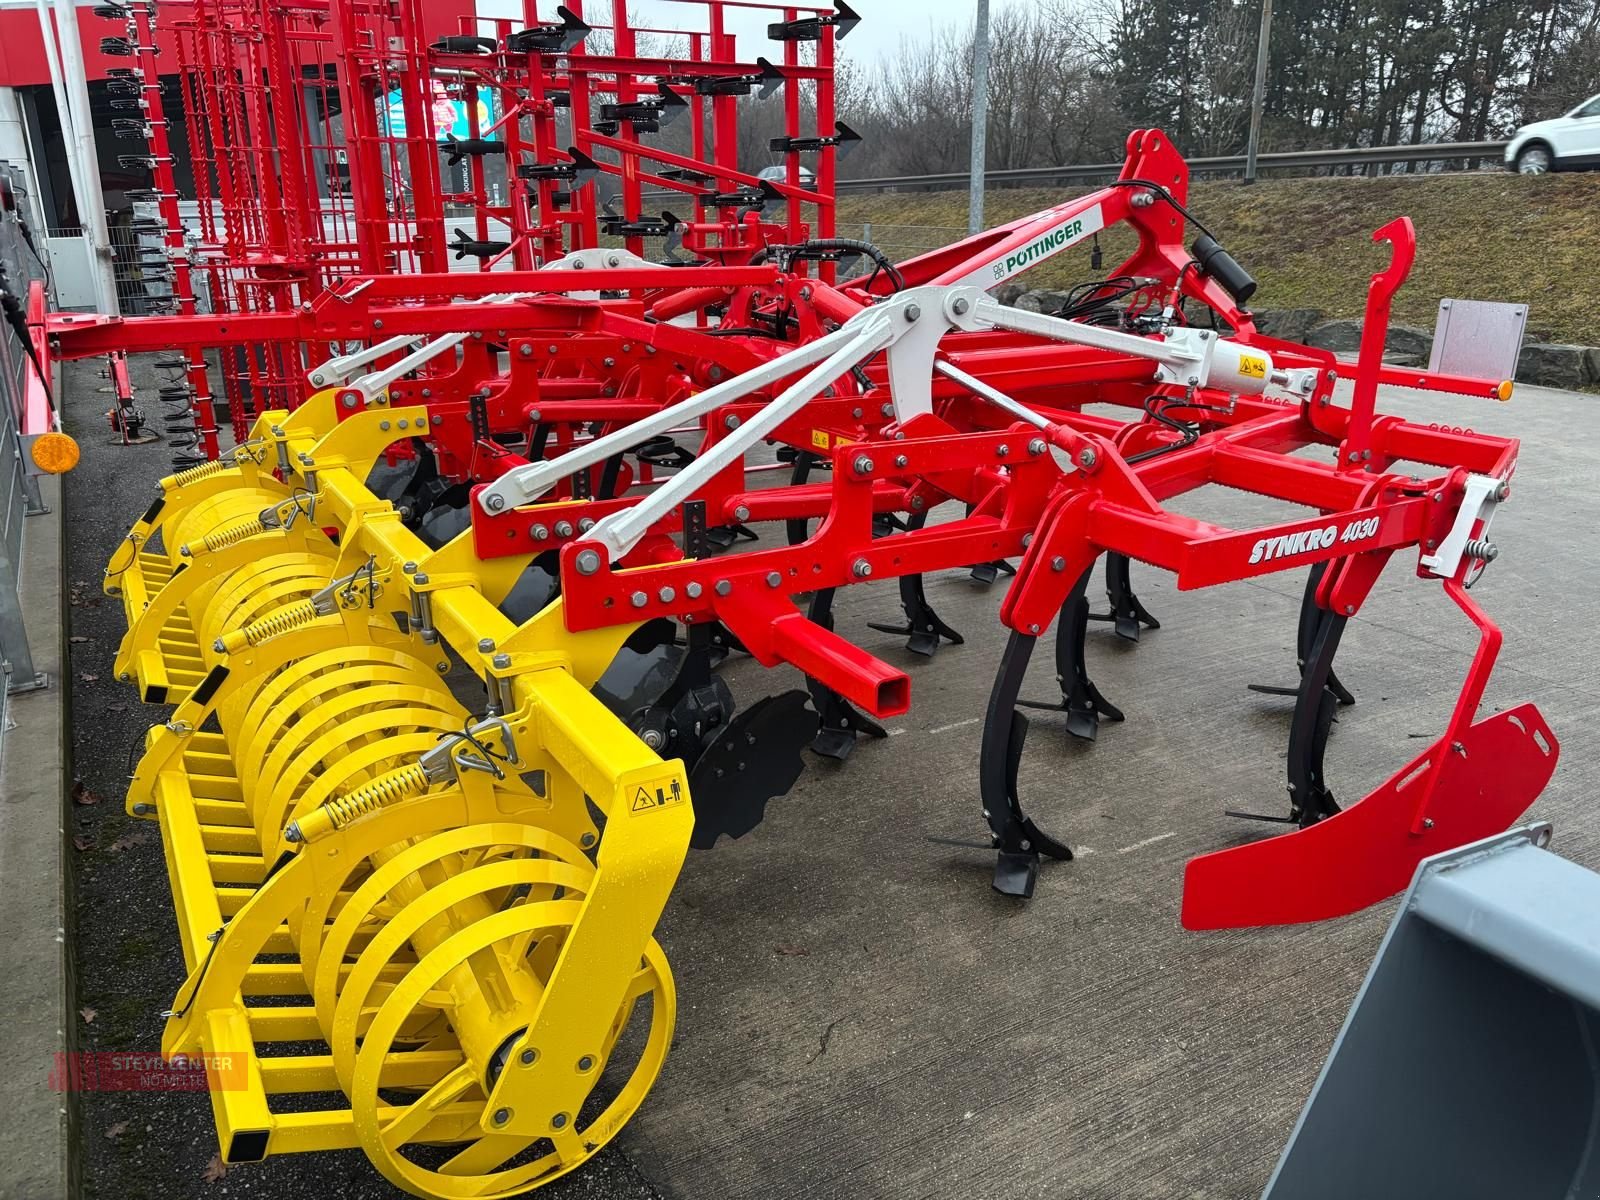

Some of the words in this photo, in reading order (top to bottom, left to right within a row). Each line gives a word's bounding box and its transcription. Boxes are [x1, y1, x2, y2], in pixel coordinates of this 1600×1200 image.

[1006, 220, 1083, 272] PÖTTINGER
[1248, 525, 1338, 564] SYNKRO
[1340, 516, 1380, 543] 4030
